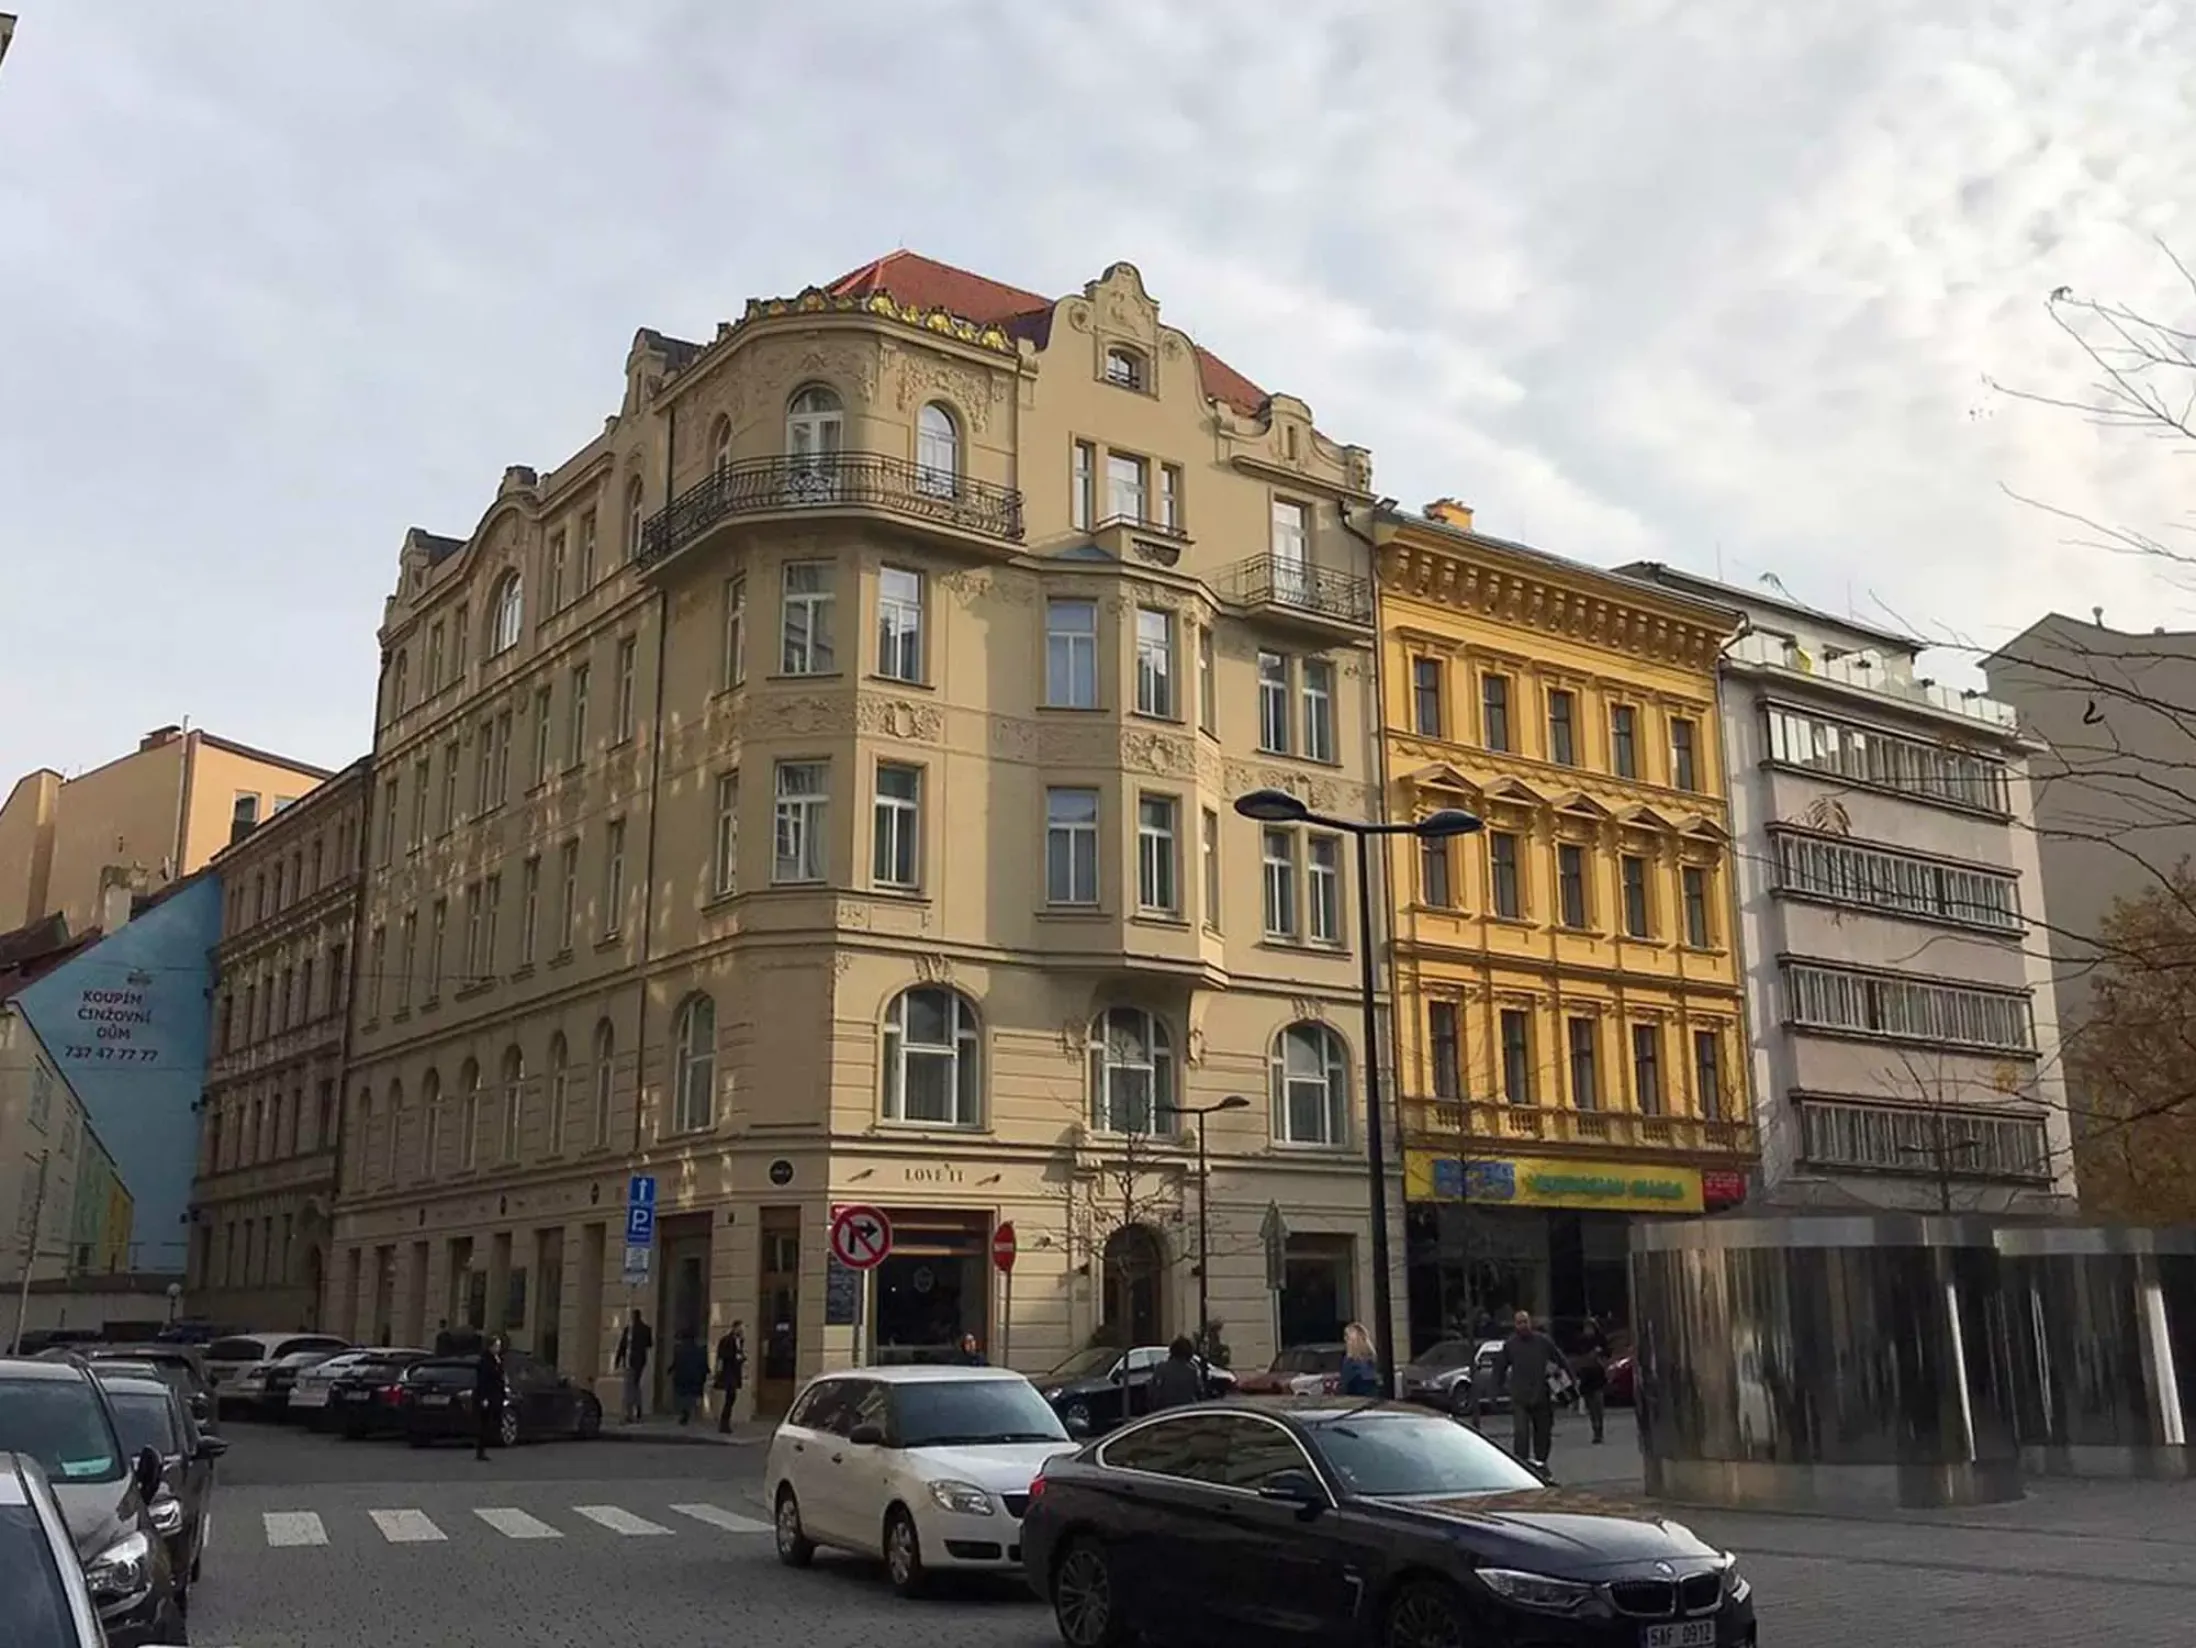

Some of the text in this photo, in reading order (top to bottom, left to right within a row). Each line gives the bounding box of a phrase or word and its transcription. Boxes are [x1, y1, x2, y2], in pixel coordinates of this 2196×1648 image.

[82, 990, 142, 1004] KOUPÍM
[96, 1023, 131, 1040] DŮM
[64, 1045, 159, 1062] 737 47 77 77
[631, 1209, 649, 1232] P
